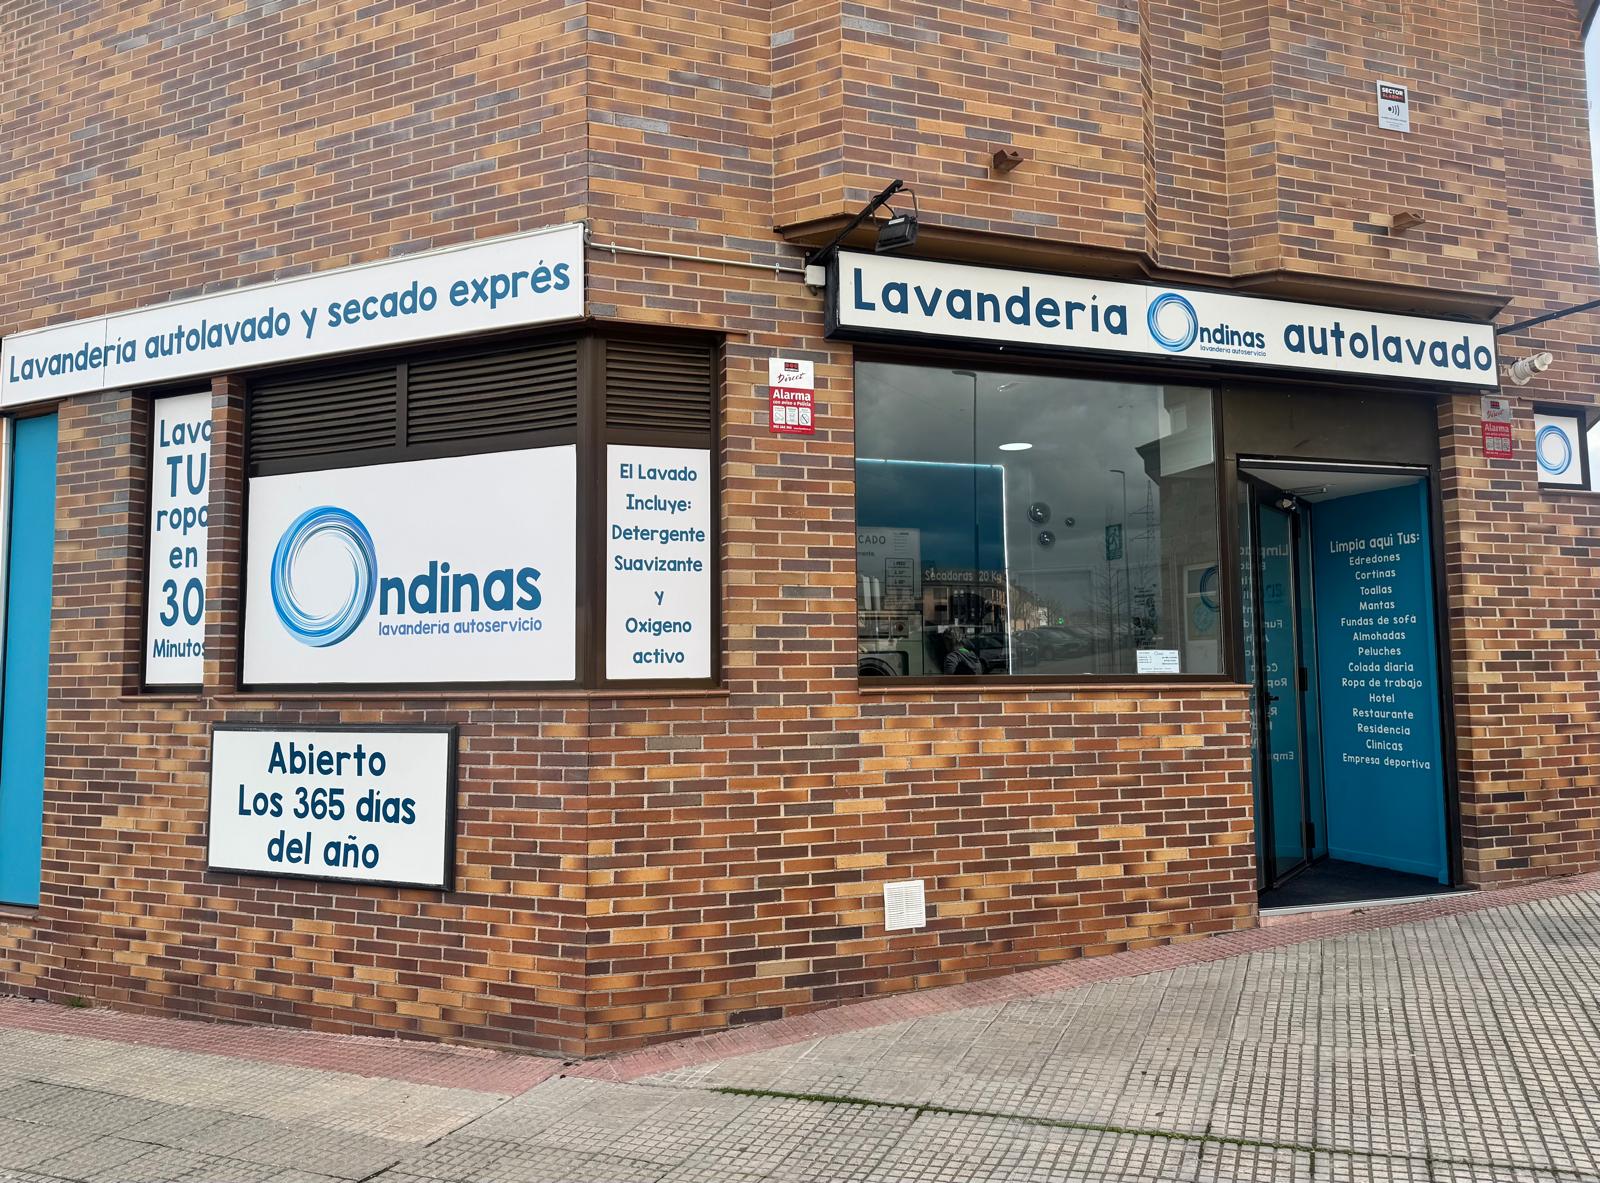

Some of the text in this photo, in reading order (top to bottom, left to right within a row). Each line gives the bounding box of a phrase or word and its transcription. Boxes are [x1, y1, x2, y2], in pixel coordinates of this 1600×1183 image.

[1381, 87, 1403, 96] SECTOR
[853, 267, 1128, 335] Lavandería
[9, 259, 570, 382] Lavandería autolavado y secado exprés
[1231, 348, 1266, 357] autoservicio
[1283, 321, 1492, 371] autolavado
[773, 389, 811, 401] Alarma
[1485, 423, 1509, 433] Alarma
[167, 452, 206, 497] TU
[620, 463, 697, 481] El Lavado
[626, 493, 692, 514] Incluye:
[612, 524, 705, 544] Detergente
[1330, 537, 1365, 553] Limpia
[1397, 531, 1420, 545] Tus:
[169, 546, 198, 569] en
[614, 555, 703, 572] Suavizante
[1349, 552, 1401, 566] Edredones
[1355, 569, 1396, 580] Cortinas
[654, 591, 664, 605] y
[1360, 585, 1393, 596] Toallas
[159, 577, 205, 627] 30
[1359, 600, 1395, 611] Mantas
[453, 617, 542, 634] autoservicio
[1341, 617, 1373, 627] Fundas
[1377, 615, 1390, 625] de
[1353, 630, 1406, 641] Almohadas
[633, 648, 684, 664] activo
[1358, 646, 1402, 656] Peluches
[1348, 662, 1414, 672] Colada diaria
[1342, 677, 1423, 690] Ropa de trabajo
[1369, 693, 1395, 703] Hotel
[1352, 707, 1414, 719] Restaurante
[1357, 723, 1411, 736] Residencia
[268, 741, 386, 777] Abierto
[1342, 753, 1430, 770] Empresa deportiva
[238, 784, 416, 825] Los 365 días
[267, 830, 379, 869] del año
